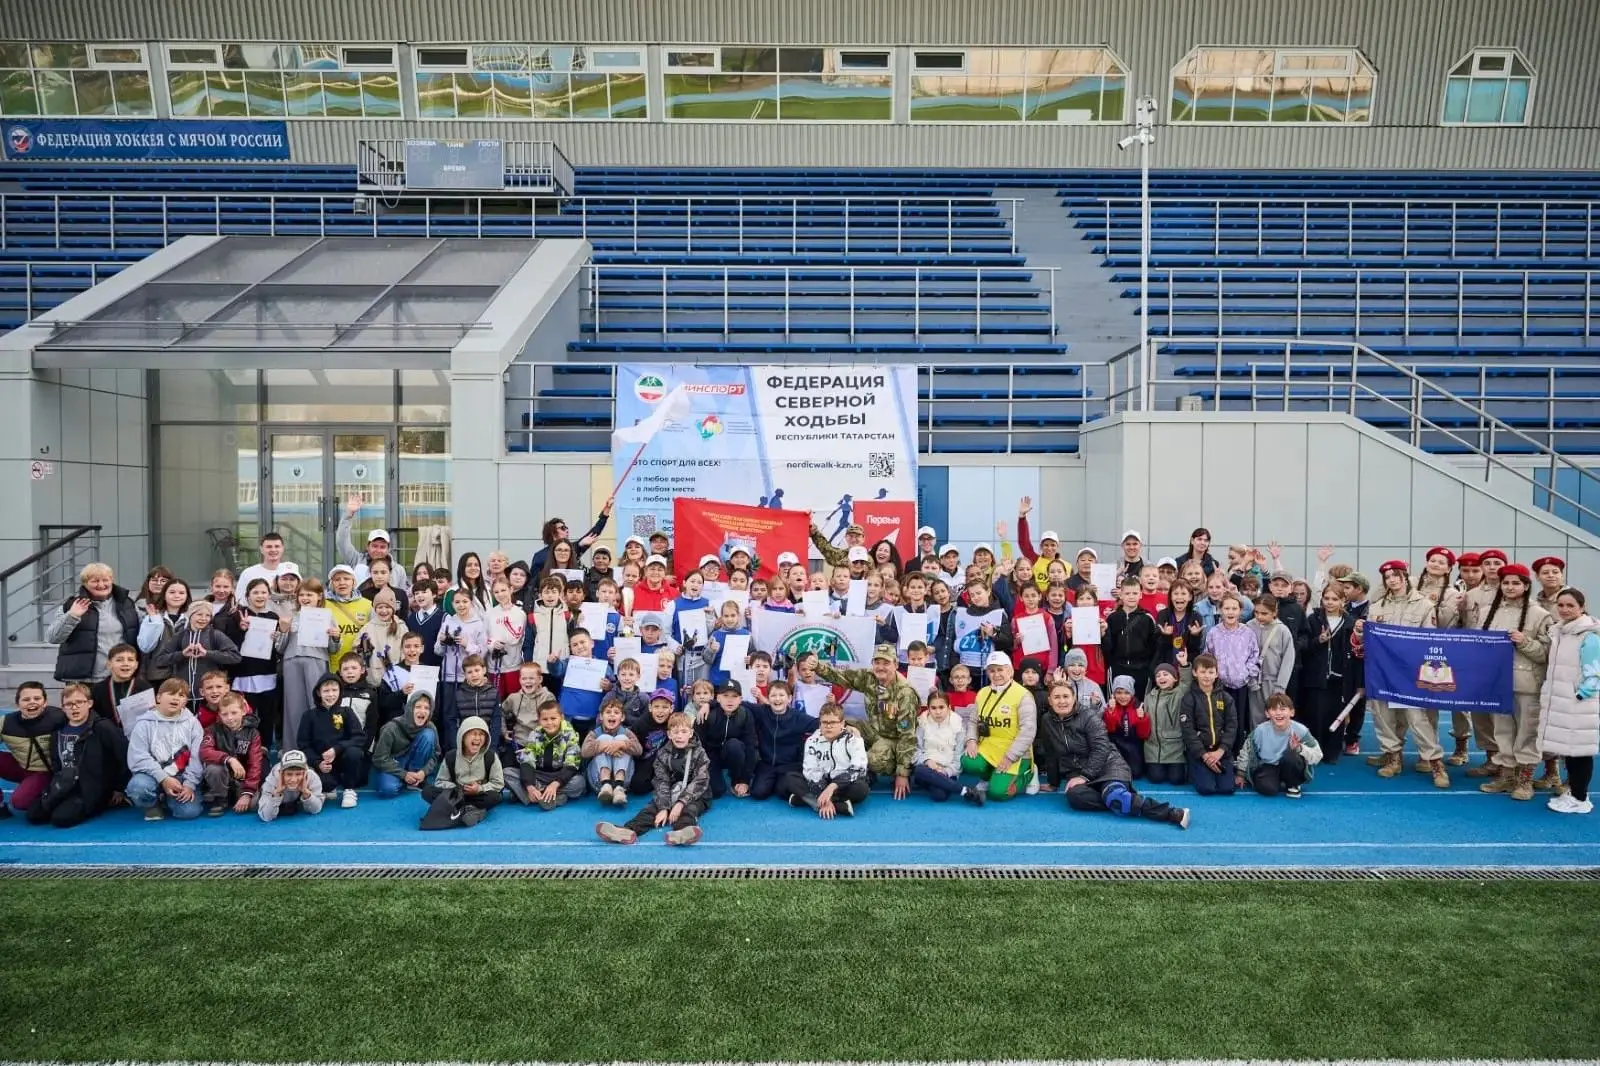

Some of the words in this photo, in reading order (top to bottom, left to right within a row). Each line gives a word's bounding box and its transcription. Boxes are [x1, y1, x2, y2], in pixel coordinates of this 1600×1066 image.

[37, 133, 112, 149] ФЕДЕРАЦИЯ
[115, 133, 165, 147] ХОККЕЯ
[168, 133, 176, 147] С
[179, 133, 227, 147] МЯЧОМ
[230, 133, 283, 147] РОССИИ
[766, 375, 884, 391] ФЕДЕРАЦИЯ
[775, 392, 876, 409] СЕВЕРНОЙ
[784, 412, 866, 428] ХОДЬБЫ
[840, 432, 895, 440] ТАТАРСТАН
[679, 459, 696, 467] ДЛЯ
[698, 459, 721, 467] ВСЕХ!
[786, 460, 863, 469] nordicwalk-kzn.ru
[643, 485, 670, 493] любом
[643, 495, 670, 503] любом
[866, 514, 901, 527] Первые
[961, 635, 977, 649] 27
[984, 716, 1011, 728] ДЬЯ
